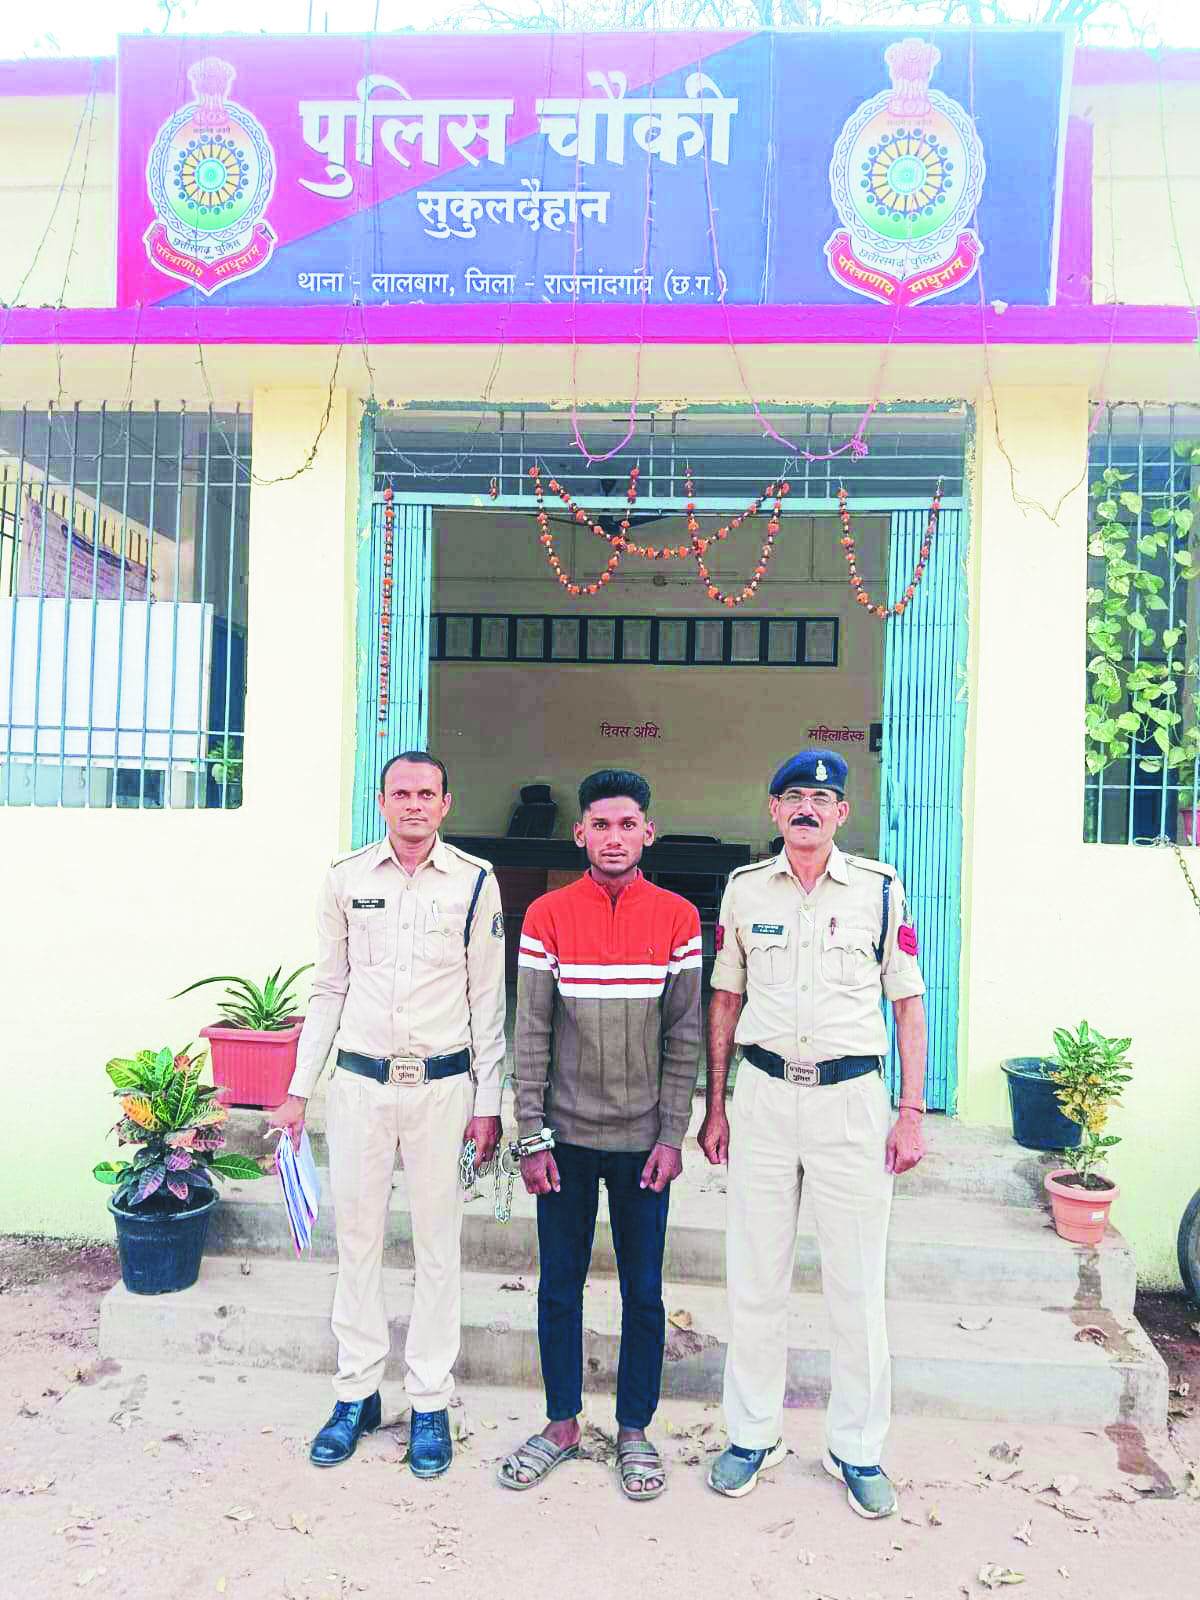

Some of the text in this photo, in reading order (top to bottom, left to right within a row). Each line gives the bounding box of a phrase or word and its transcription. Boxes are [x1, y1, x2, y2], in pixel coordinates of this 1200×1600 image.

[298, 71, 738, 199] पुलिस चौकी
[417, 178, 611, 239] सुकुलदैहान
[298, 272, 344, 293] थाना
[371, 273, 455, 297] लालबाग,
[464, 266, 516, 294] जिला
